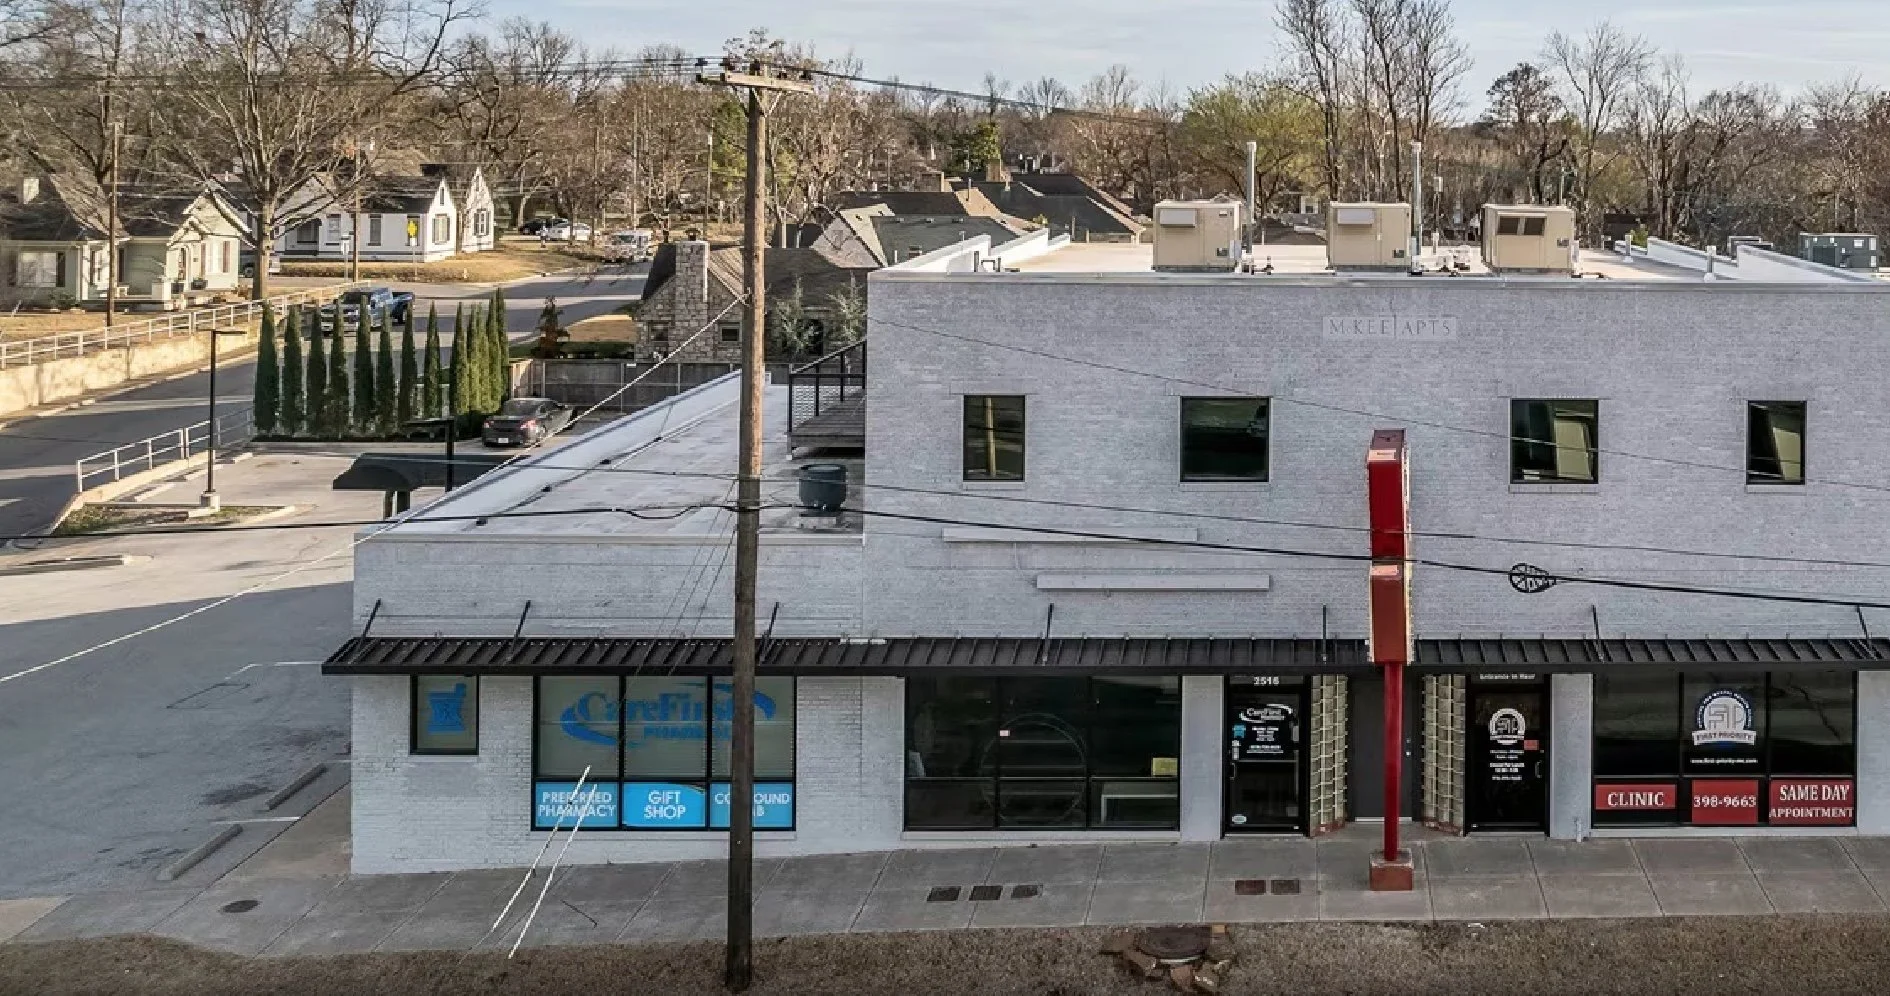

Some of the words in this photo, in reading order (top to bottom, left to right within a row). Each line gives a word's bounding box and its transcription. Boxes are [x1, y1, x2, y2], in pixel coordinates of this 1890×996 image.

[1402, 319, 1450, 336] APTS
[1718, 731, 1752, 741] PRIORITY
[542, 791, 612, 803] PREFERRED
[648, 790, 681, 804] GIFT
[714, 793, 790, 805] COOUND
[1607, 791, 1664, 806] CLINIC
[1780, 784, 1819, 801] SAME
[1822, 784, 1850, 801] DAY
[1694, 795, 1757, 808] 398-9663
[538, 805, 616, 818] PHARMACY
[644, 805, 686, 819] SHOP
[1769, 806, 1854, 818] APPOINTMENT
